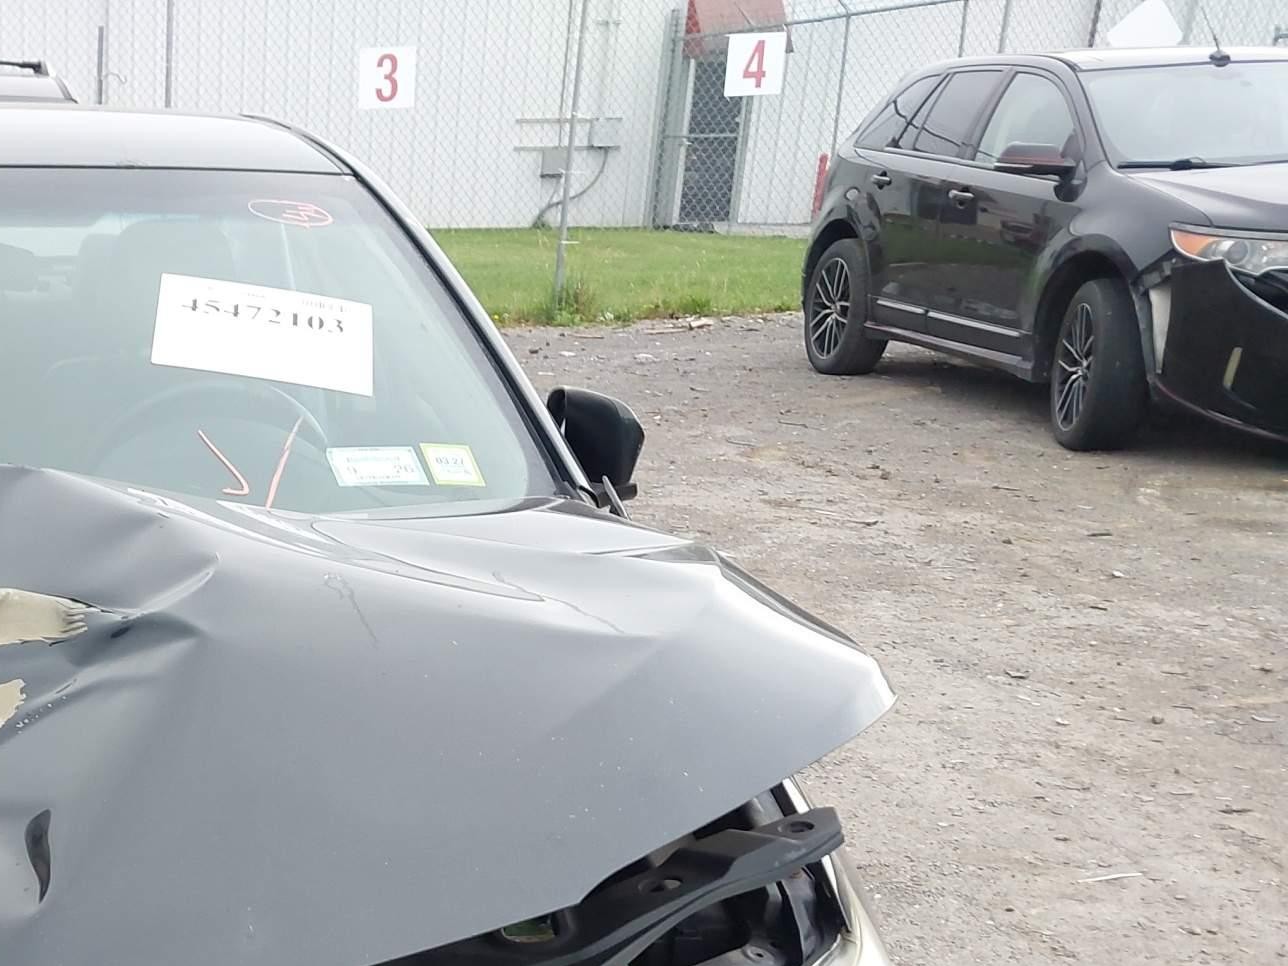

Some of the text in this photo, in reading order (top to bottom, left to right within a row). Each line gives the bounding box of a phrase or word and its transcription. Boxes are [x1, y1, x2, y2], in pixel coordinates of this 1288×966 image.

[374, 53, 401, 103] 3
[741, 40, 768, 91] 4
[181, 297, 345, 334] 45472103
